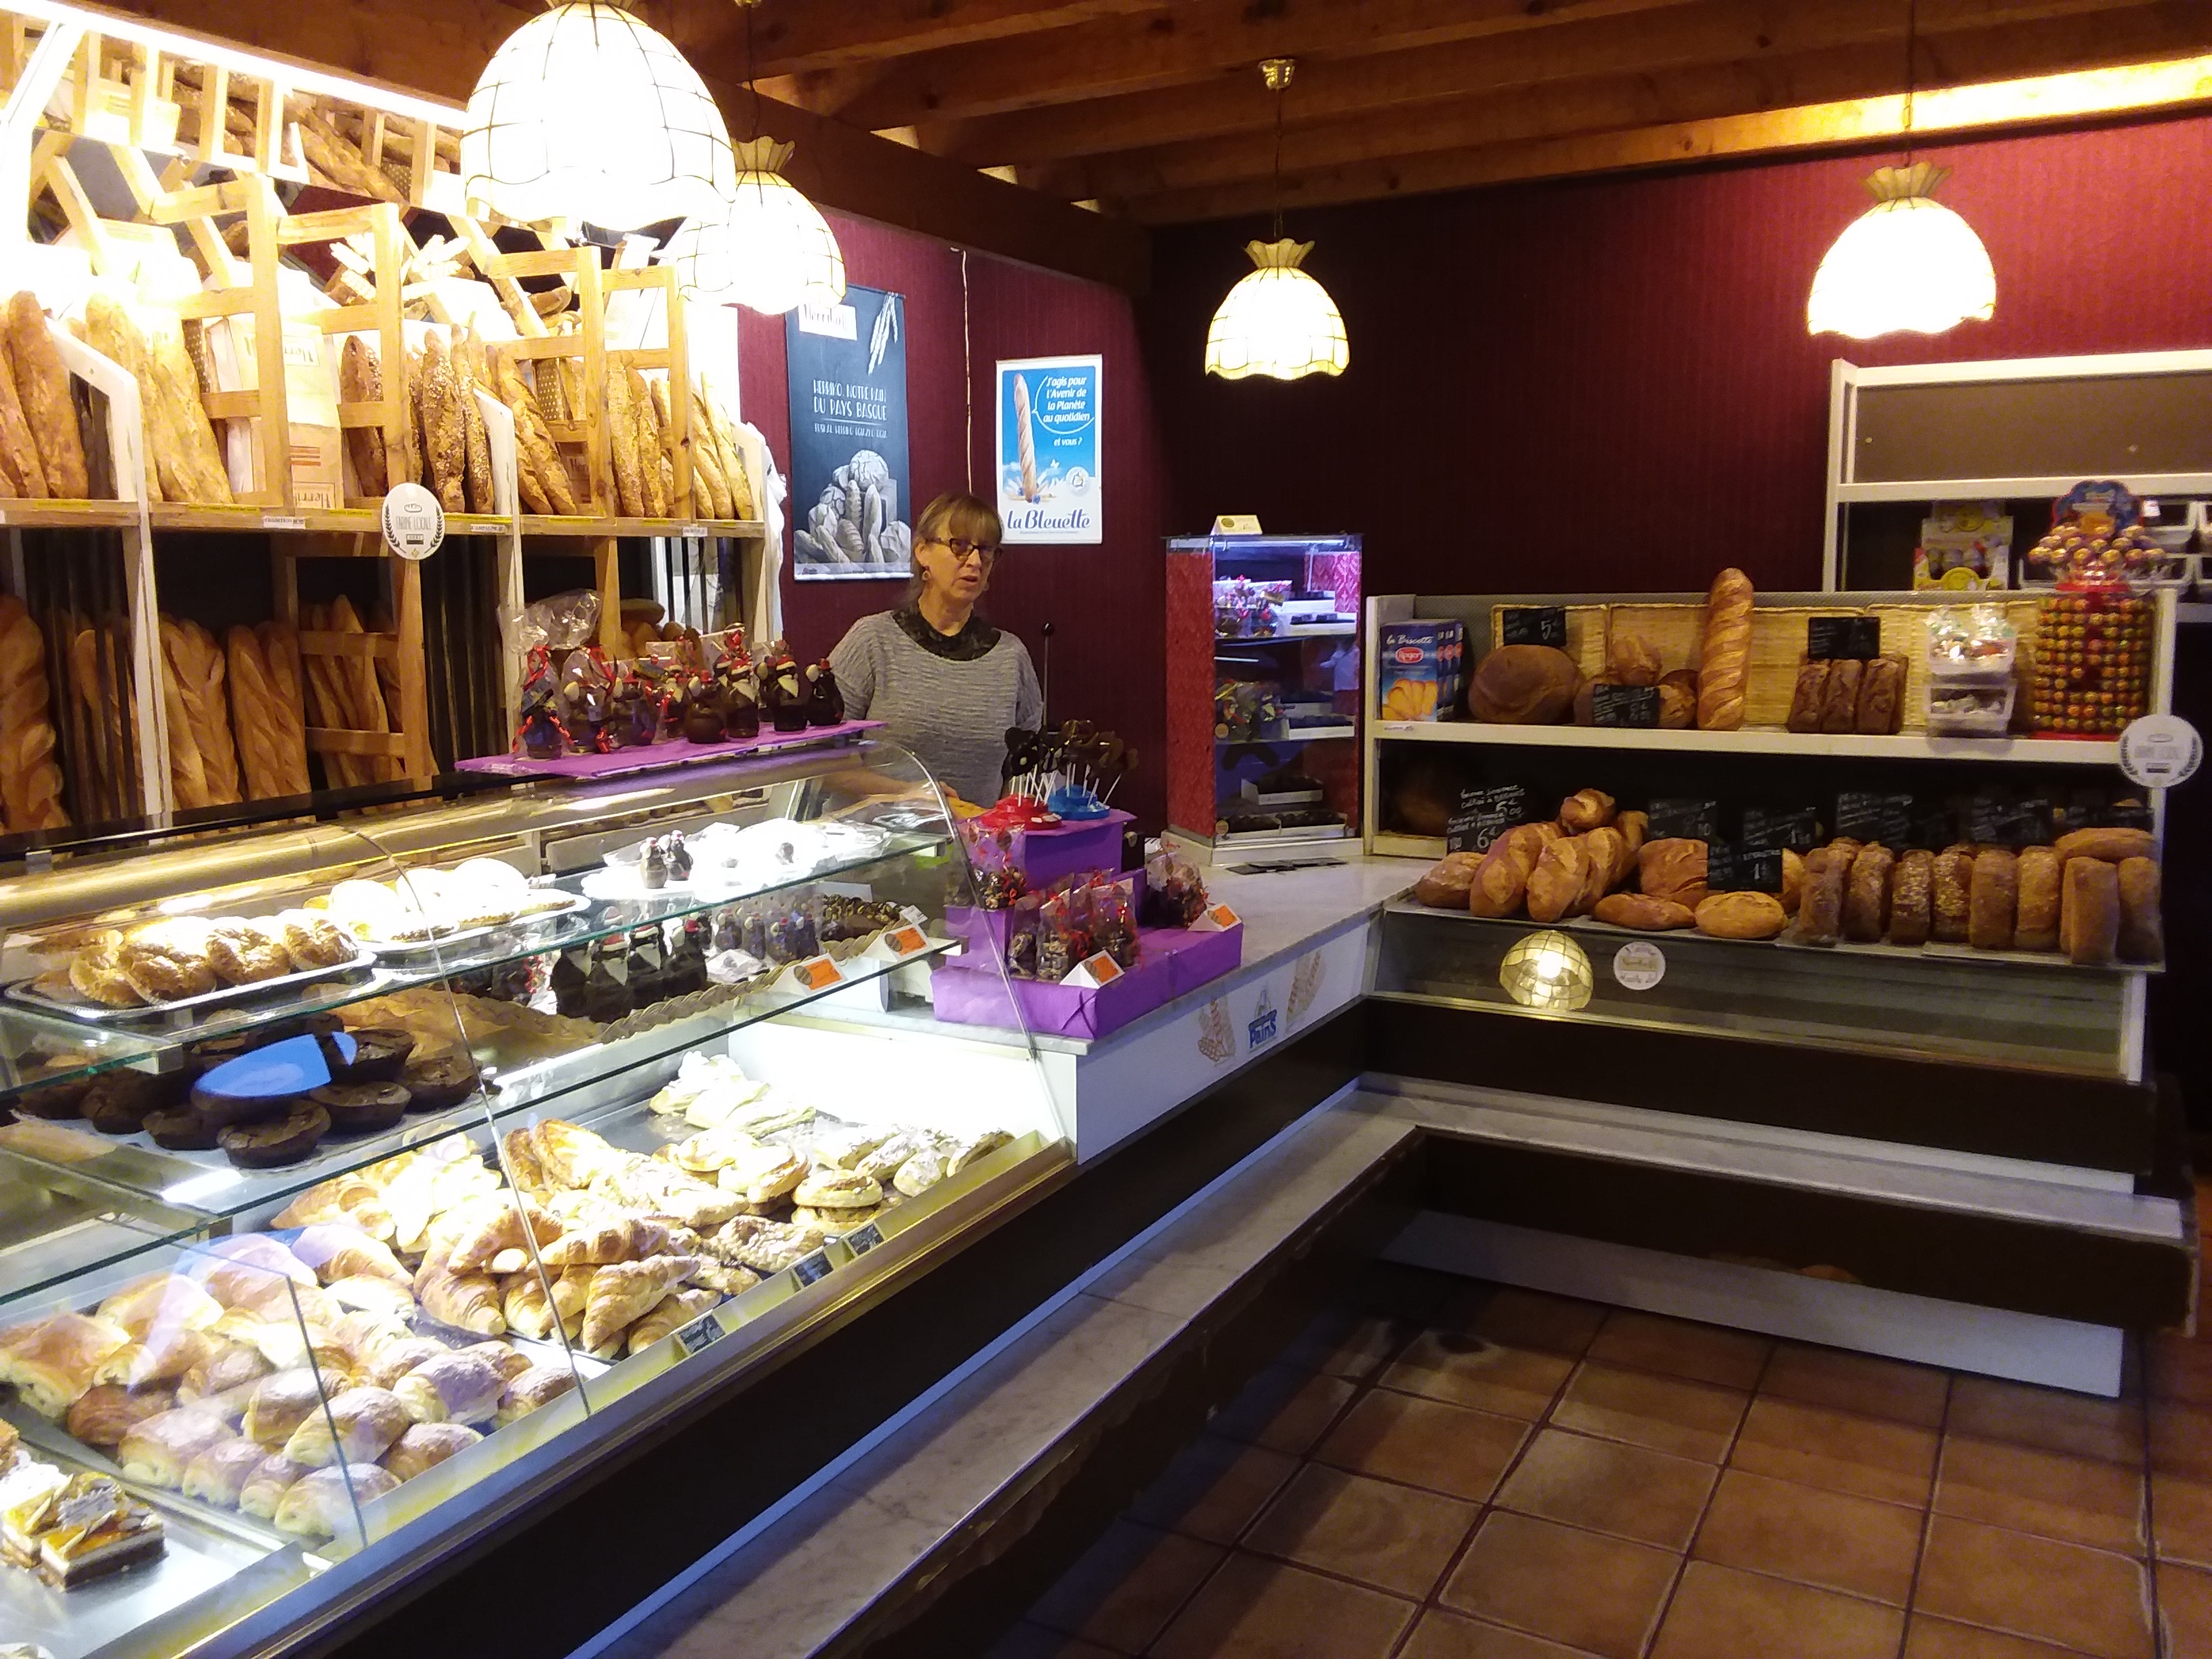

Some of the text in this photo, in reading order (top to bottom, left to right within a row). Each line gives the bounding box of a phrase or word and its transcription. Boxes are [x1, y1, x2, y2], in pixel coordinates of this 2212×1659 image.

[1046, 376, 1087, 388] J'agis pour
[1046, 388, 1087, 398] l'Avenir de
[814, 396, 887, 421] DU PAYS BASQUE
[1048, 400, 1086, 411] la Planète
[1043, 411, 1090, 424] au quotidien
[1054, 438, 1061, 446] et
[1007, 509, 1090, 529] la Bleuette
